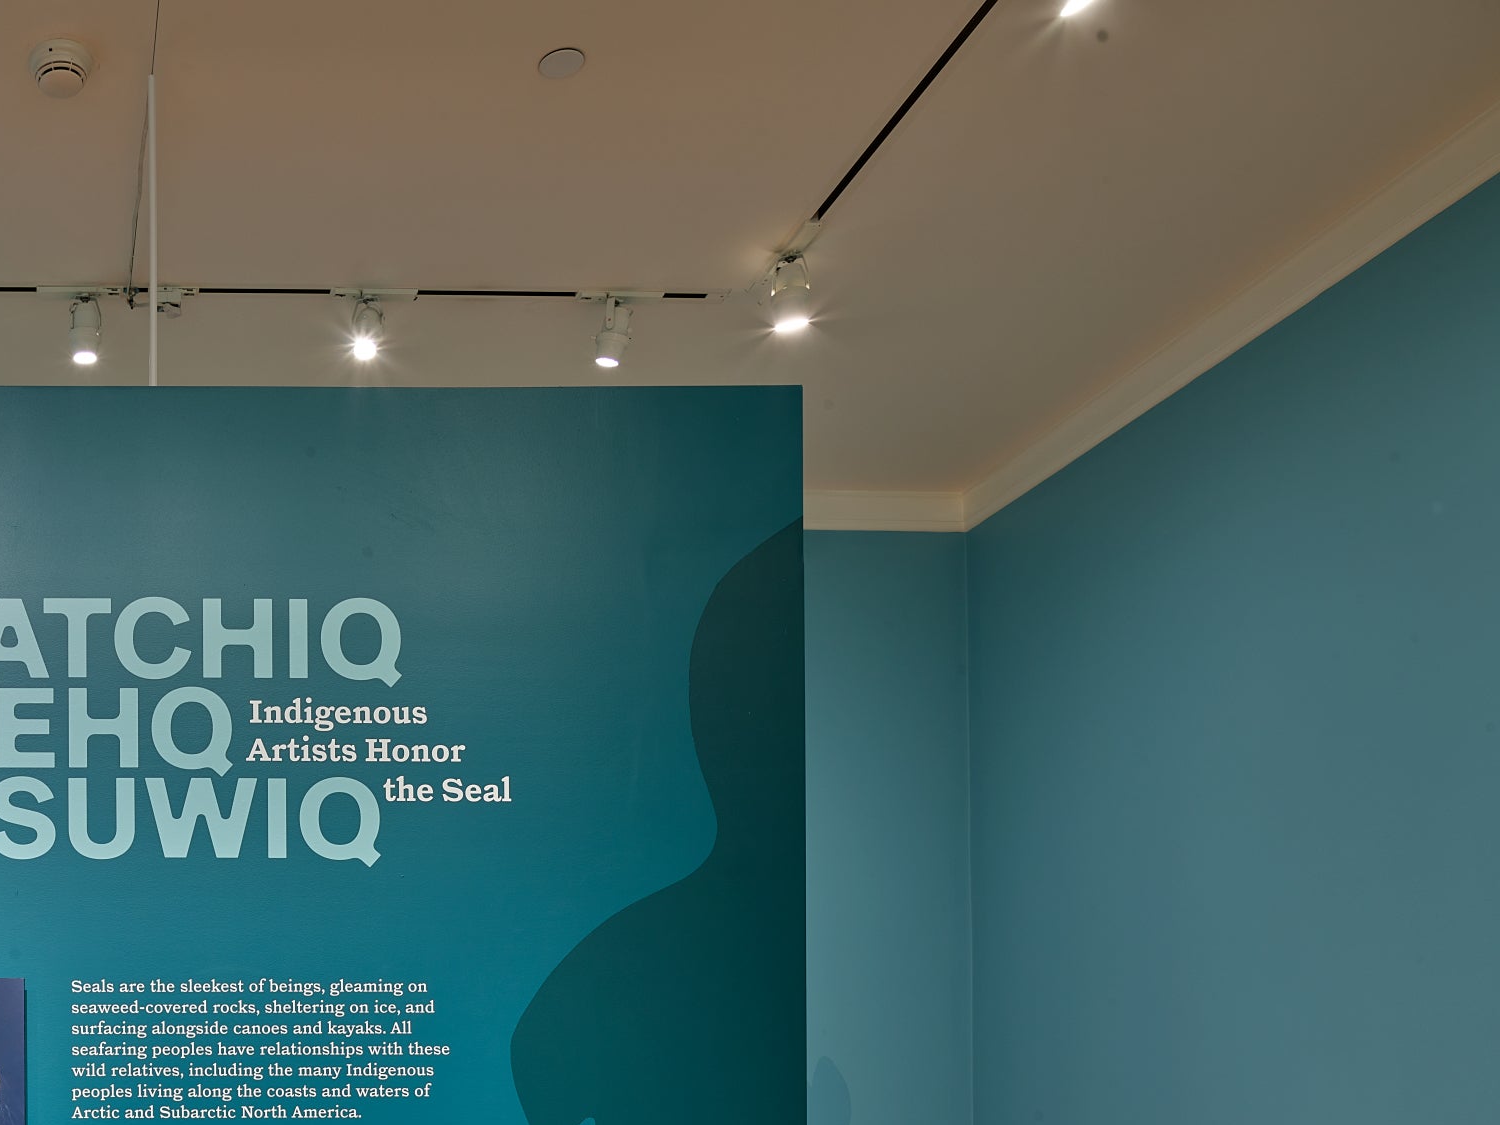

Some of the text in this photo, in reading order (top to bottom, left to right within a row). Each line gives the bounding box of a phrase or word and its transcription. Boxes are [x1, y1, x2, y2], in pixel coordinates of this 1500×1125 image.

[249, 699, 428, 732] Indigenous
[246, 736, 466, 764] Artists Honor
[384, 776, 512, 803] the Seal
[71, 978, 428, 996] Seals are the sleekest of beings, gleaming on
[71, 1000, 435, 1017] seaweed-covered rocks, sheltering on ice, and
[72, 1020, 412, 1038] surfacing alongside canoes and kayaks. All
[72, 1041, 450, 1059] seafaring peoples have relationships with these
